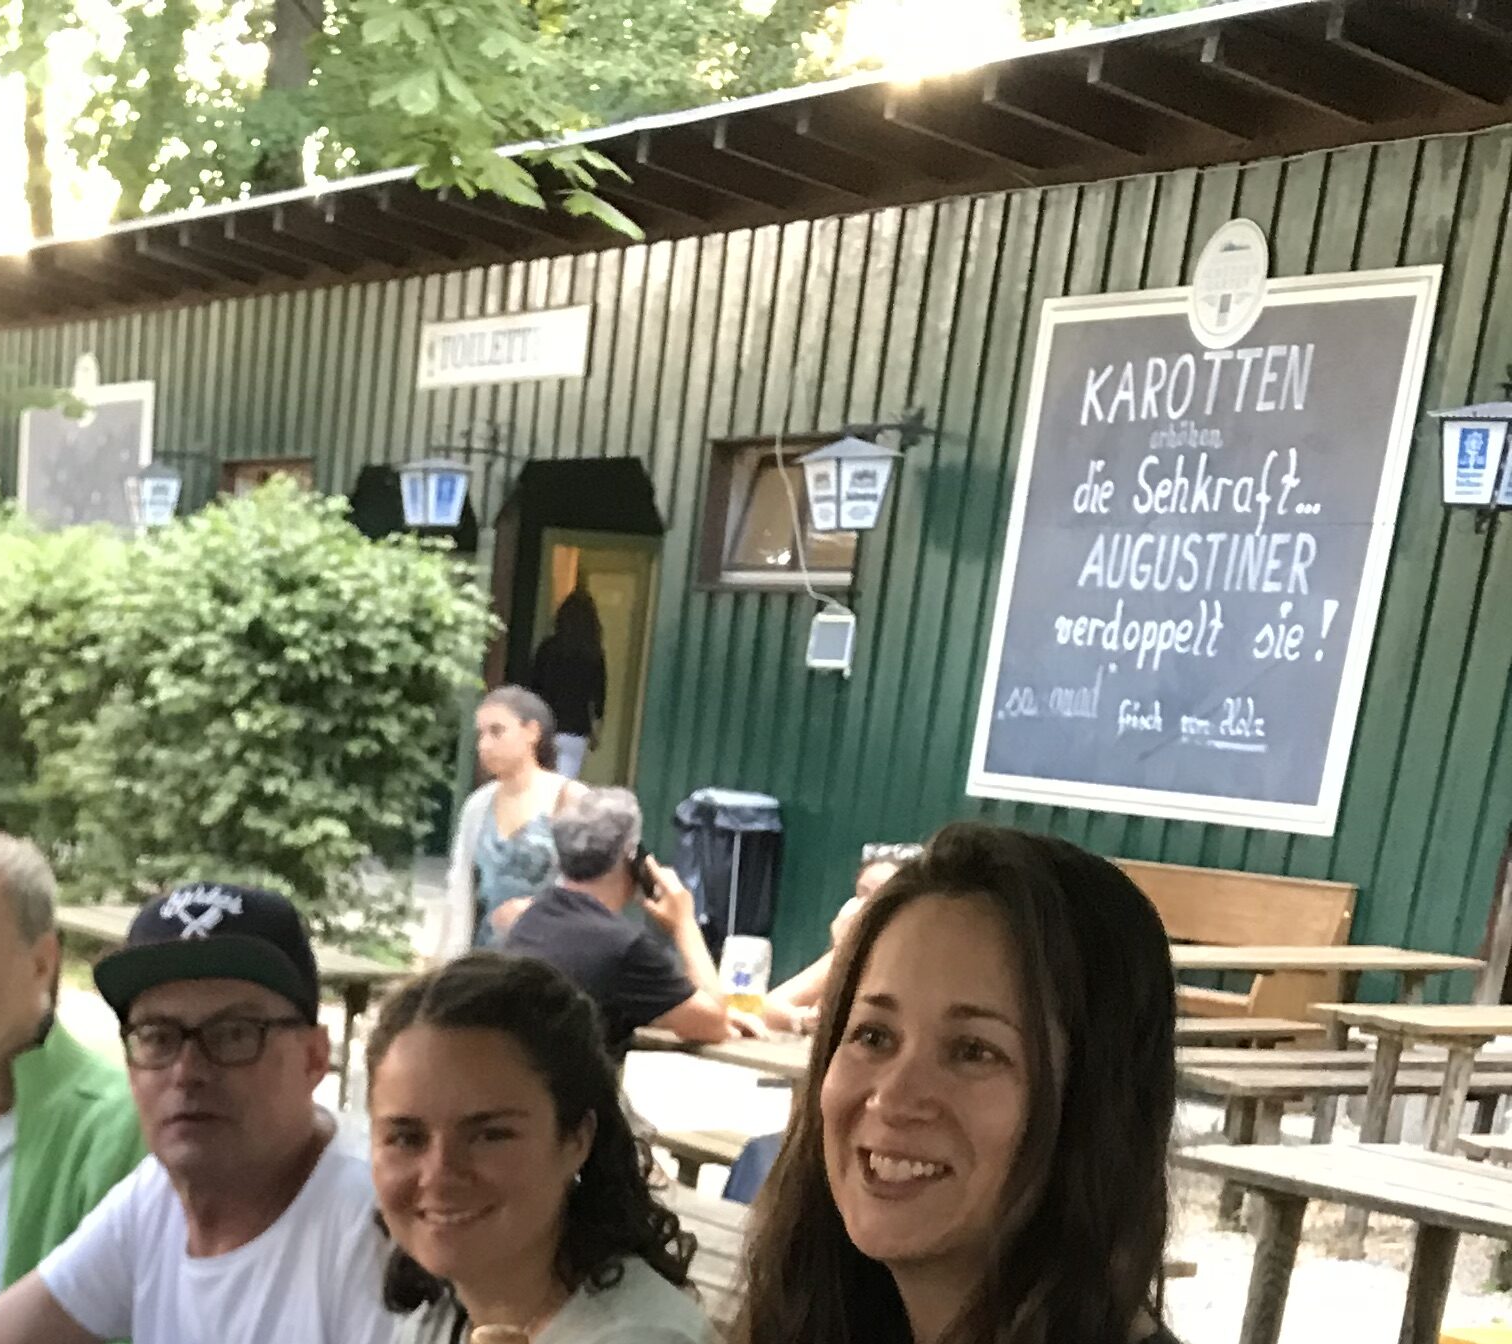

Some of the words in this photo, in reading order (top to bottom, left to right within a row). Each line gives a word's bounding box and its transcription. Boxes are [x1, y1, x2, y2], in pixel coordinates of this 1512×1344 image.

[1079, 343, 1316, 427] KAROTTEN
[1073, 458, 1115, 514] die
[1076, 531, 1318, 596] AUGUSTINER
[1054, 598, 1225, 672] verdoppelt
